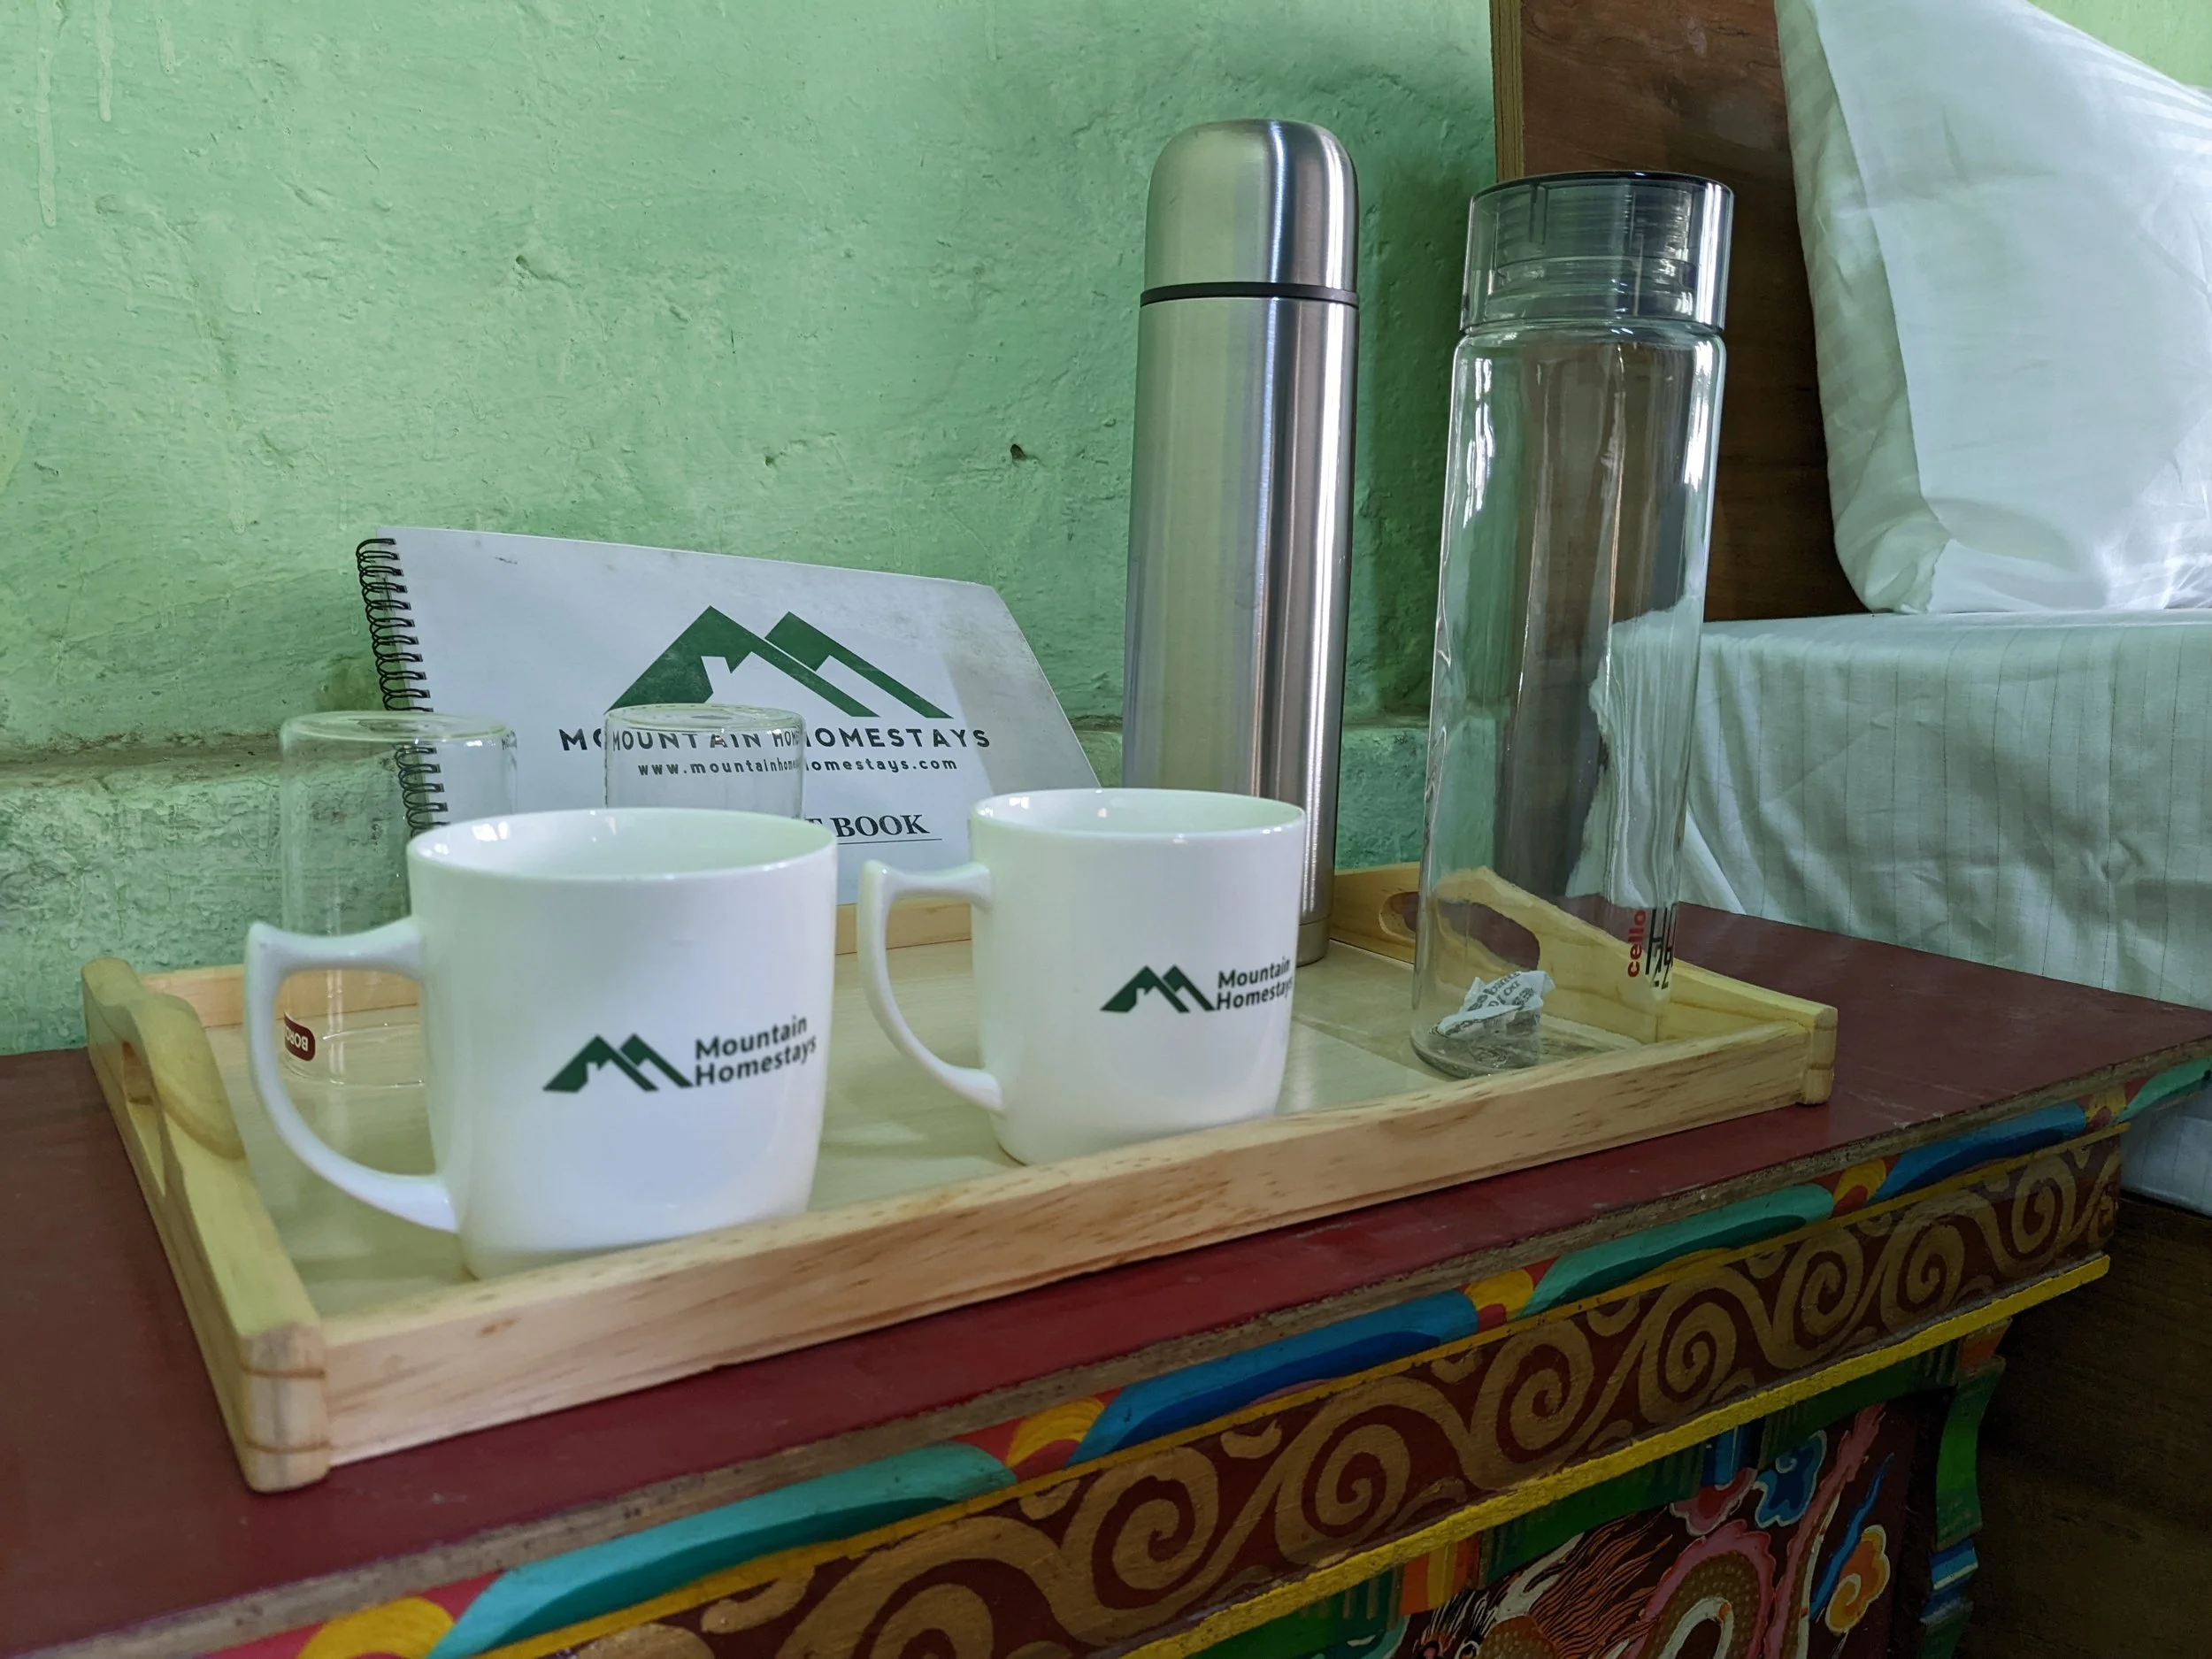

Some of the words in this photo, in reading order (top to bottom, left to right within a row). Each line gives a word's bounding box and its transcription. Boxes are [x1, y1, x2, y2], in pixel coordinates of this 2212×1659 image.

[830, 814, 931, 838] BOOK
[1627, 909, 1647, 978] cello
[1217, 956, 1291, 989] Mountain
[1217, 976, 1294, 1010] Homestays
[695, 1014, 808, 1061] Mountain
[695, 1035, 818, 1087] Homestays
